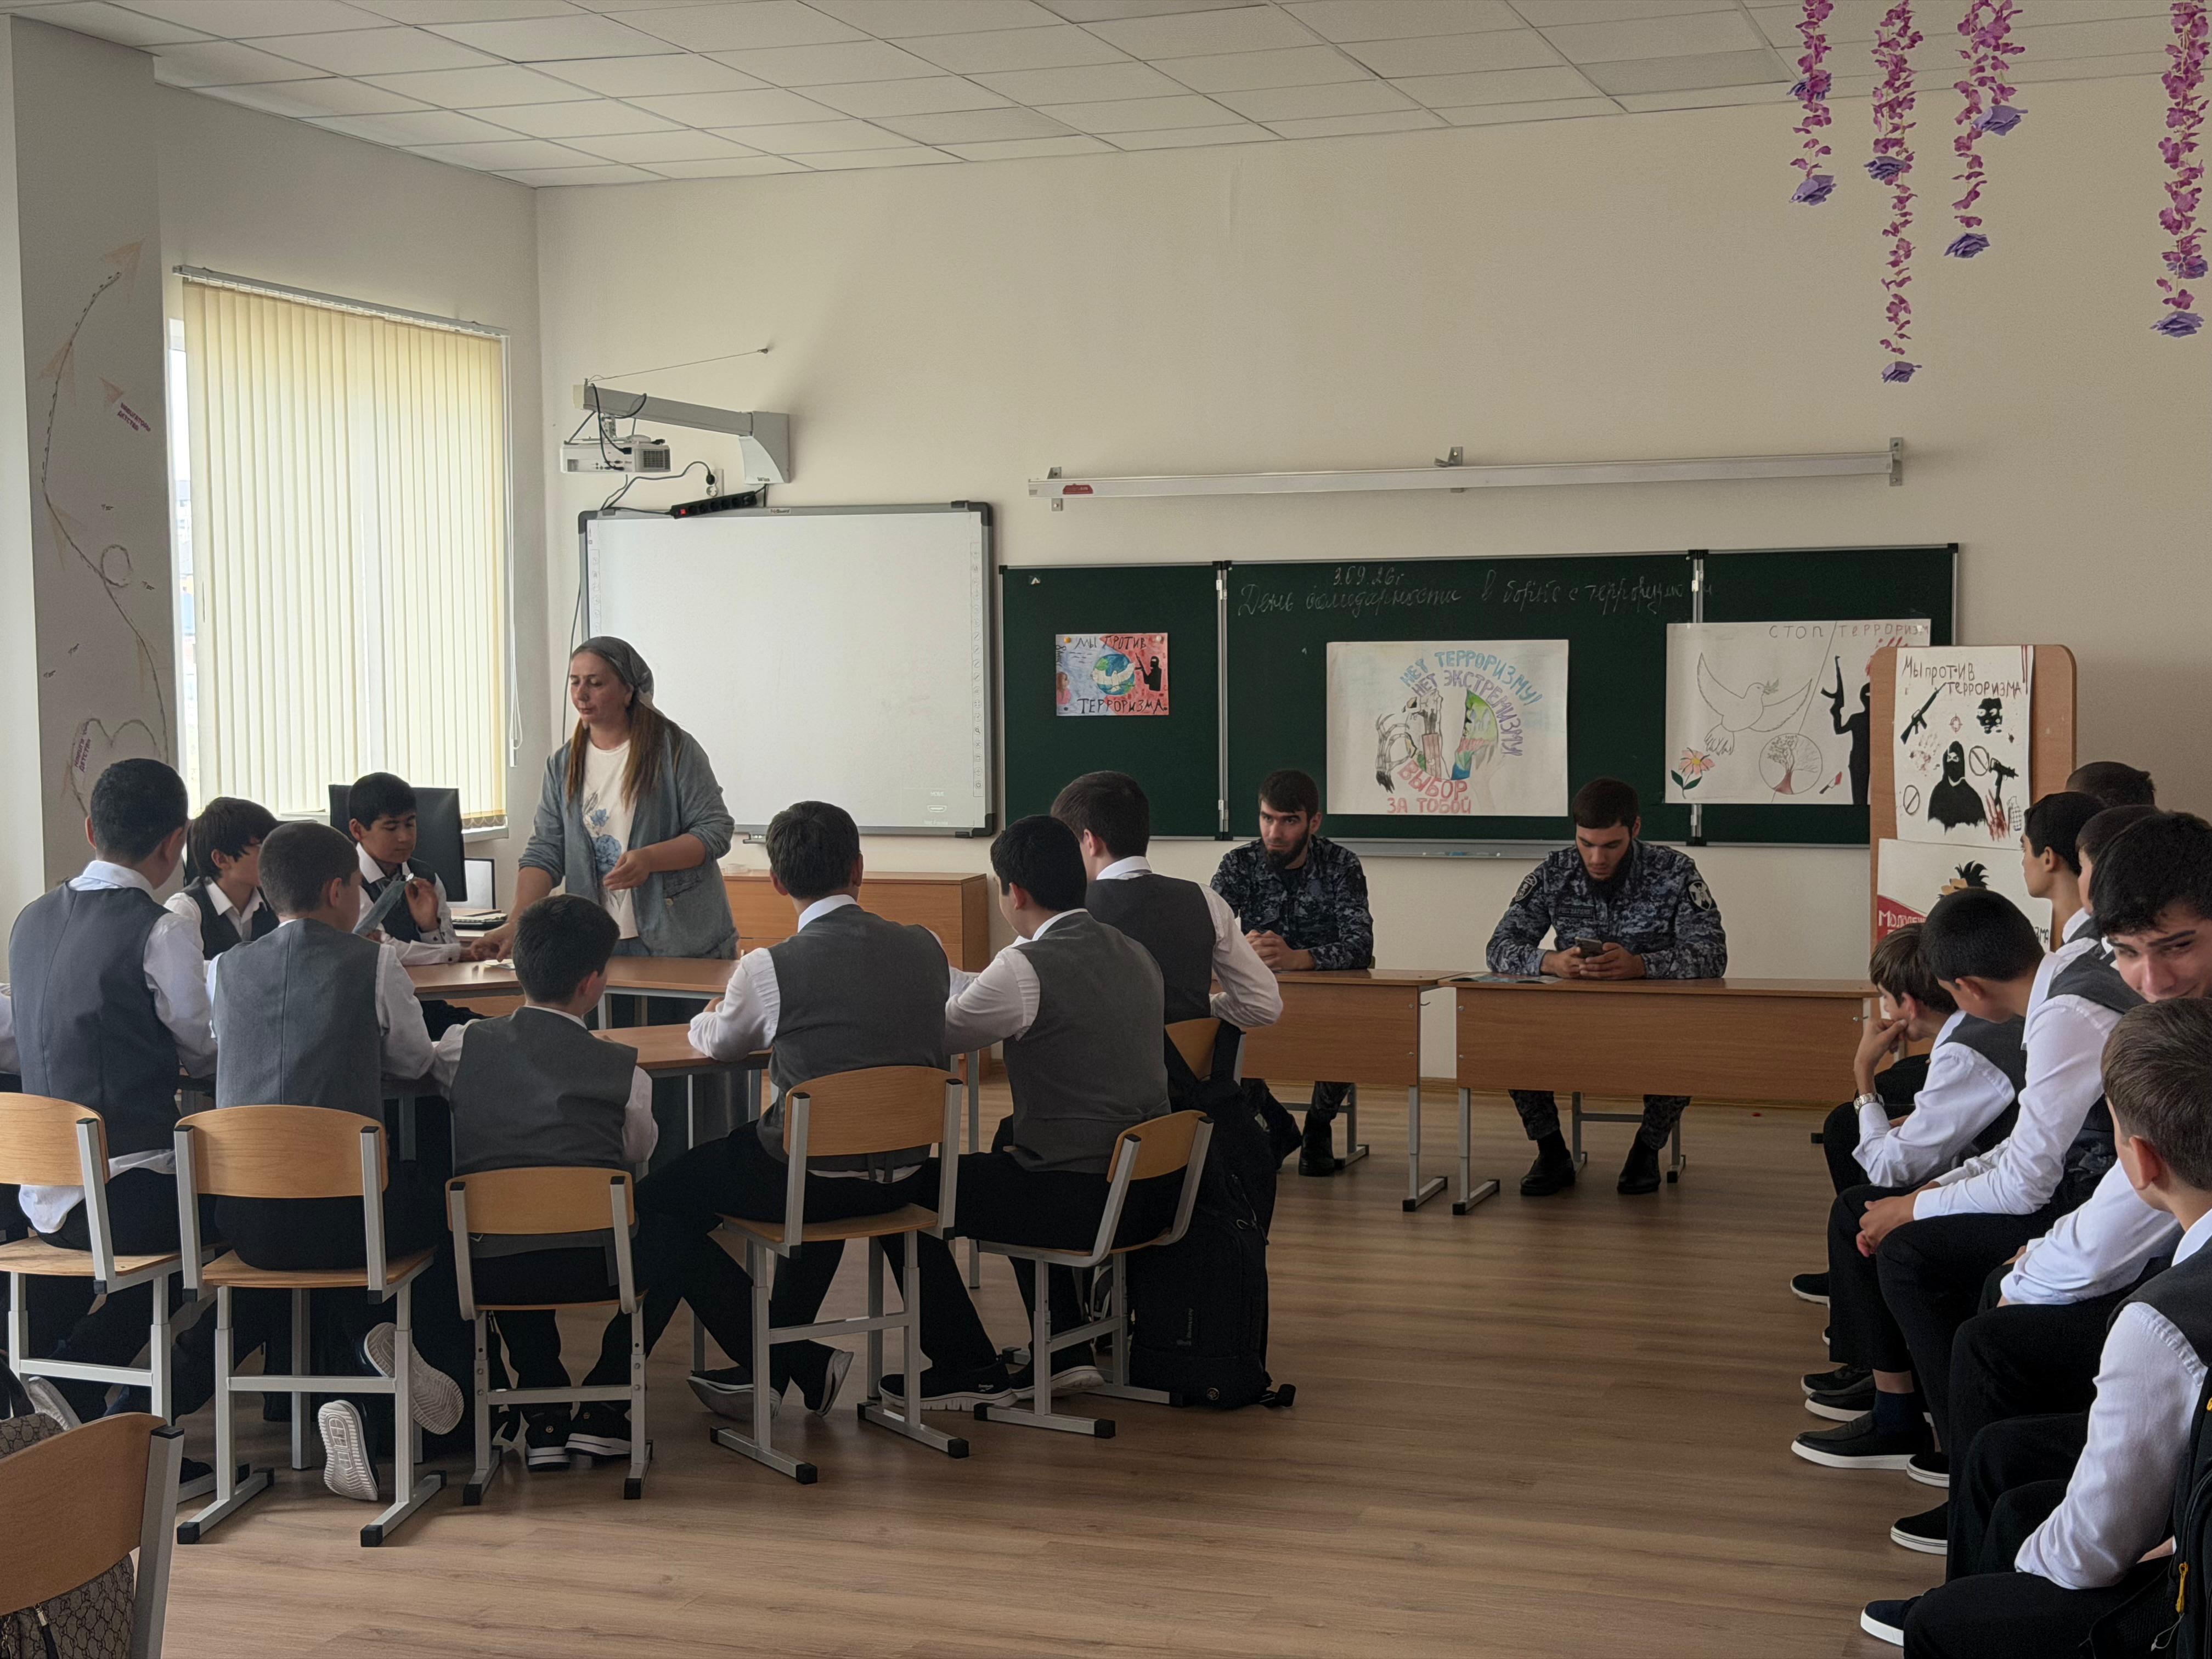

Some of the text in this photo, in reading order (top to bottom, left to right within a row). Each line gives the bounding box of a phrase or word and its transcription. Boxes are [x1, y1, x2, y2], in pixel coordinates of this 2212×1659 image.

[1238, 584, 1293, 616] День
[1074, 634, 1147, 650] МЫ ПРОТИВ
[1400, 650, 1543, 706] НЕТ ТЕРРОРИЗМУ!
[1077, 698, 1165, 714] ТЕРРОРИЗМА
[1411, 669, 1523, 757] НЕТ ЭКСТРЕМИЗМУ
[1397, 759, 1468, 800] ВЫБОР
[1387, 796, 1471, 814] ЗА ТОБОЙ
